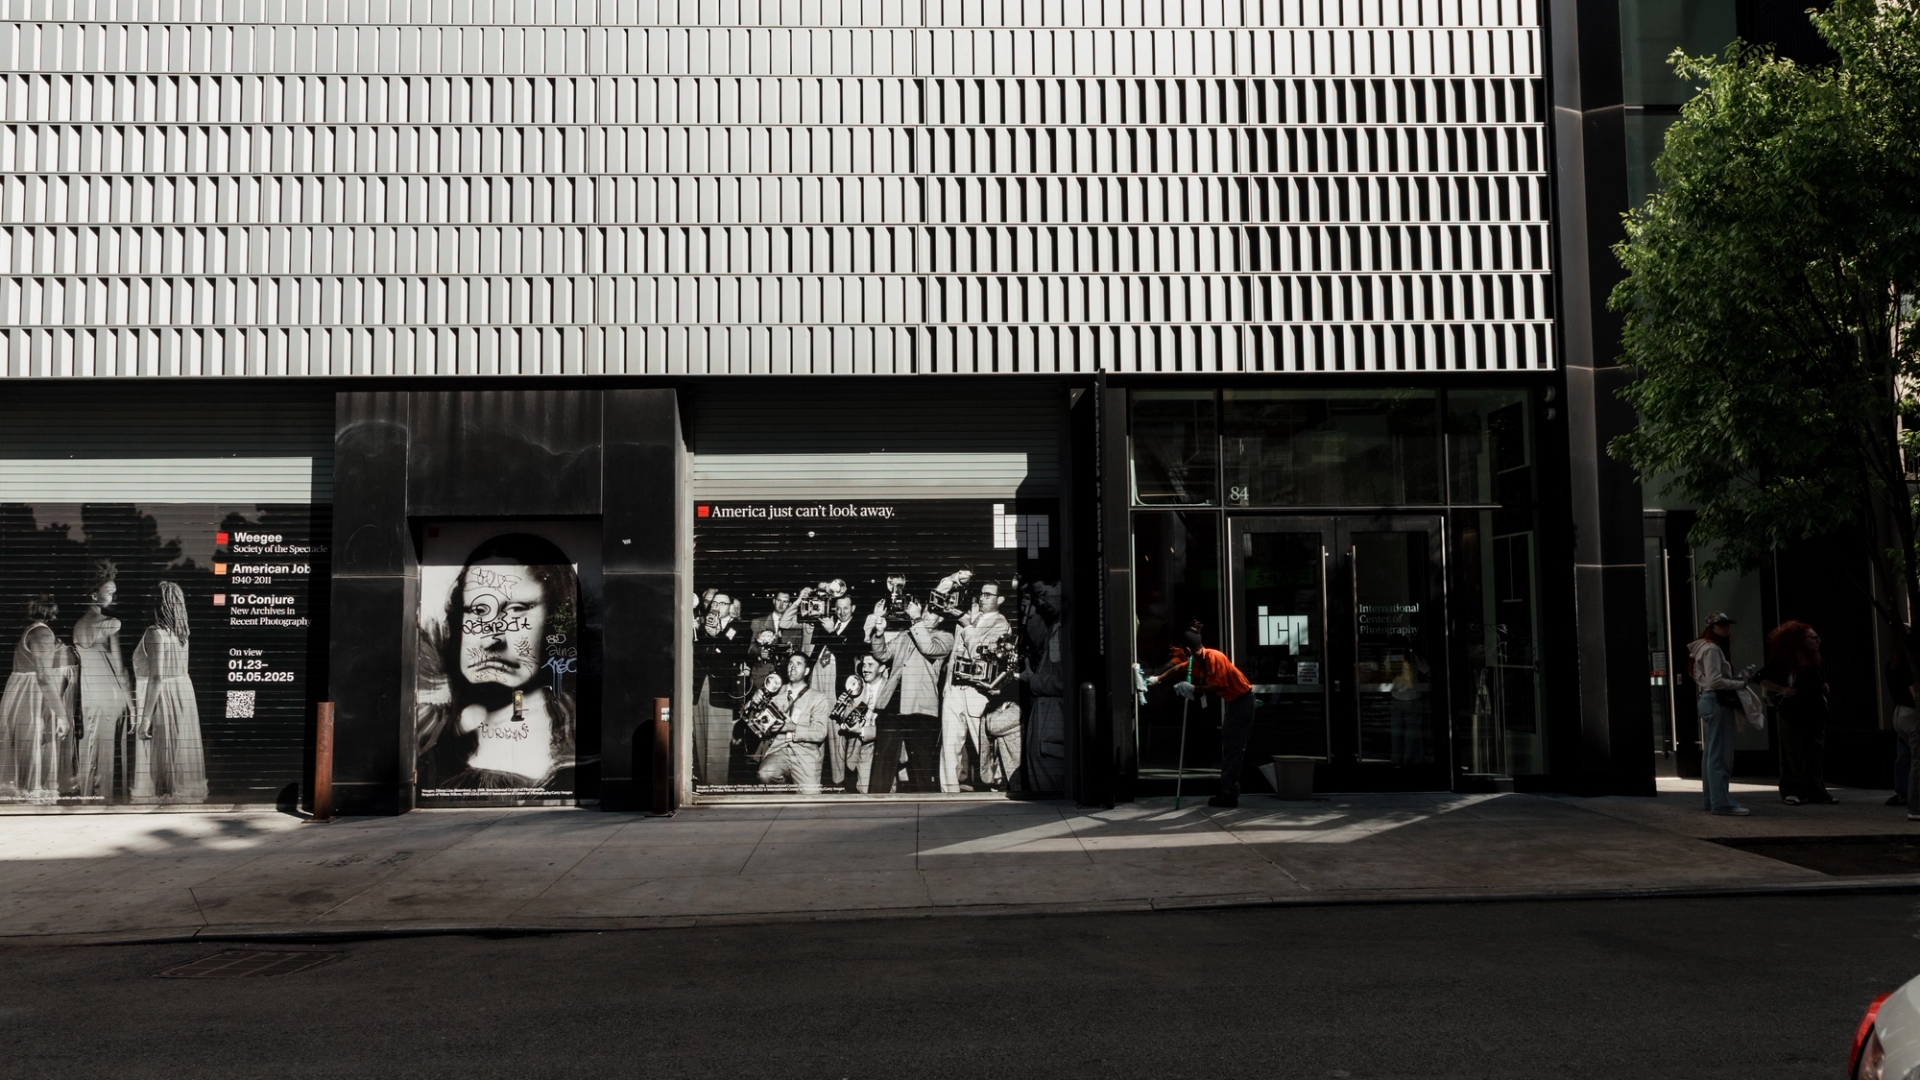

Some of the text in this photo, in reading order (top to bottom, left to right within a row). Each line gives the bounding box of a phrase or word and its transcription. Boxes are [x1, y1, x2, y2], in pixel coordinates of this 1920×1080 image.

[1230, 486, 1249, 500] 84
[712, 504, 895, 520] America just can't look away.
[234, 532, 282, 544] Weegee
[233, 545, 328, 554] Society of the Spectacle
[232, 563, 311, 574] American Job
[231, 576, 272, 584] 1940-2011
[231, 594, 294, 606] To Conjure
[250, 607, 285, 615] Archives
[287, 607, 295, 615] in
[1358, 603, 1420, 613] International
[230, 617, 312, 627] Recent Photography
[1359, 614, 1403, 624] Center of
[1258, 605, 1309, 655] icp
[1359, 624, 1420, 636] Photography
[229, 648, 262, 656] On view
[228, 672, 294, 682] 05.05.2025
